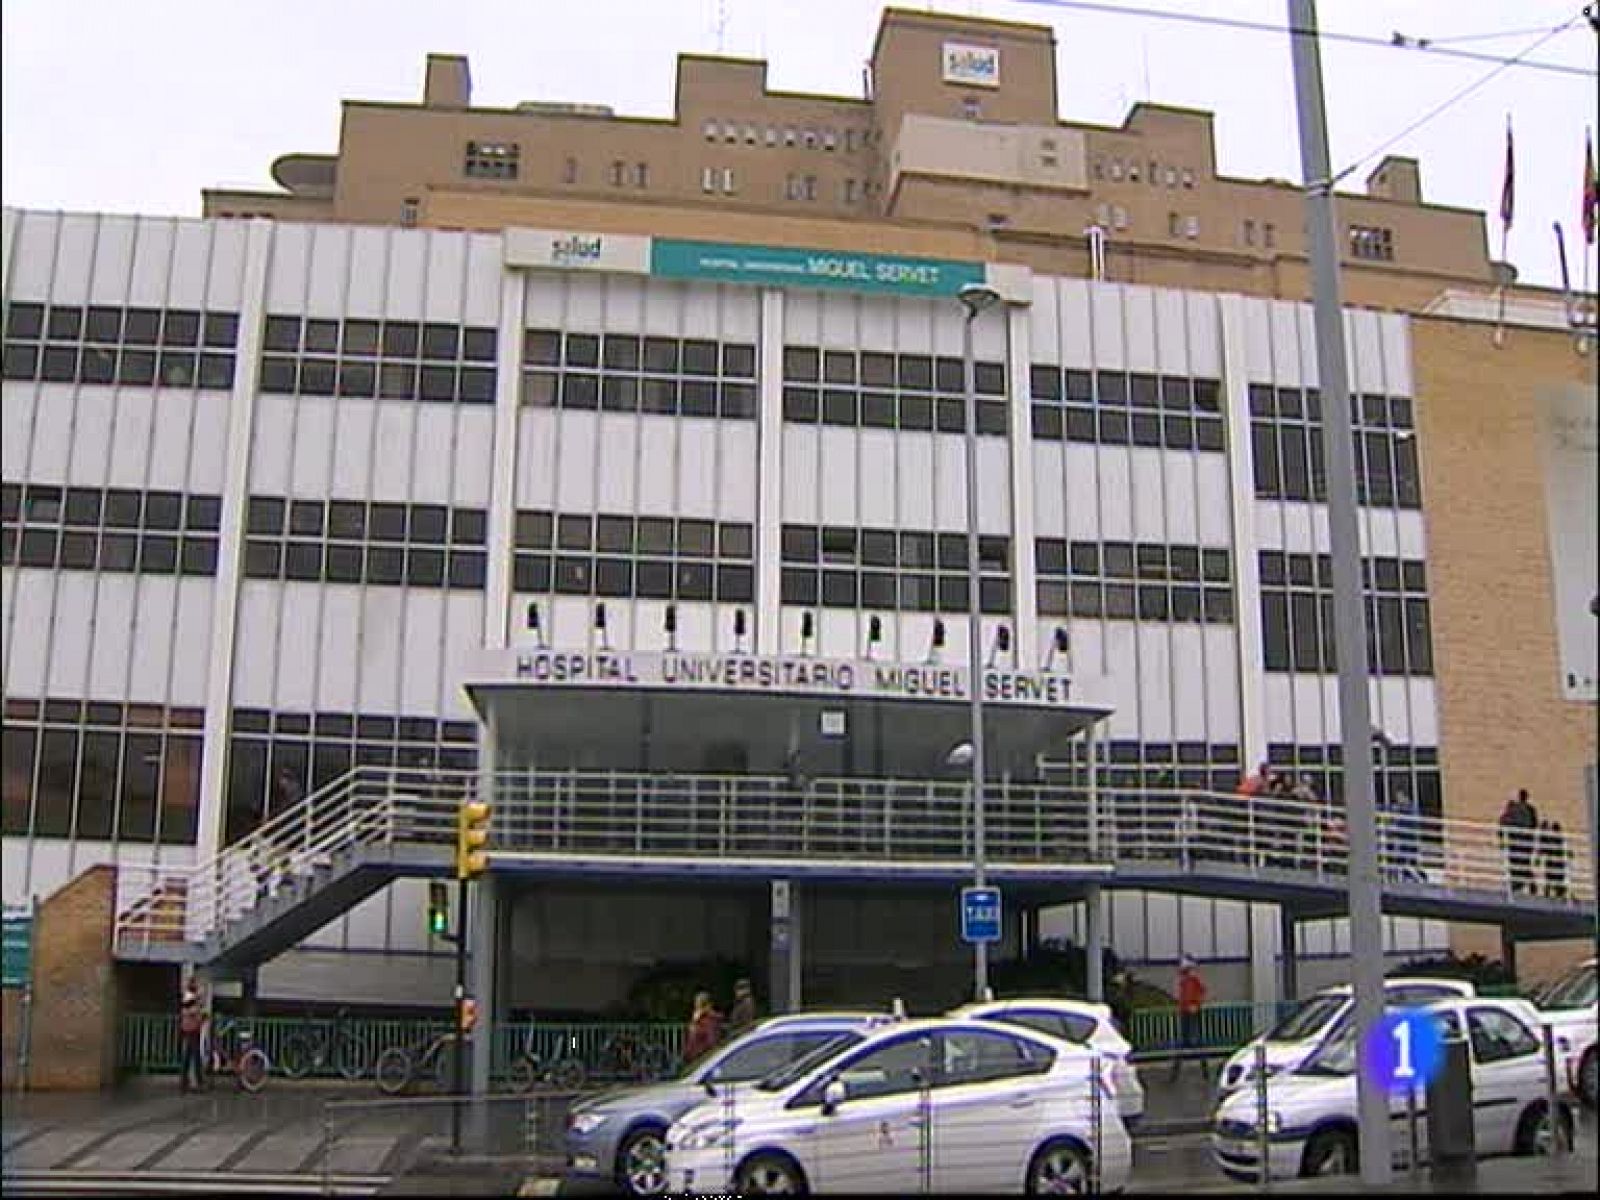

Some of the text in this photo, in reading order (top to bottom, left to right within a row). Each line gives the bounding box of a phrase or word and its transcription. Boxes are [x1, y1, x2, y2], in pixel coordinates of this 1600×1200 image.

[807, 256, 871, 281] MIGUEL
[876, 262, 940, 285] SERVET
[517, 654, 1072, 703] HOSPITAL UNIVERSITARIO MIGUEL SERVET
